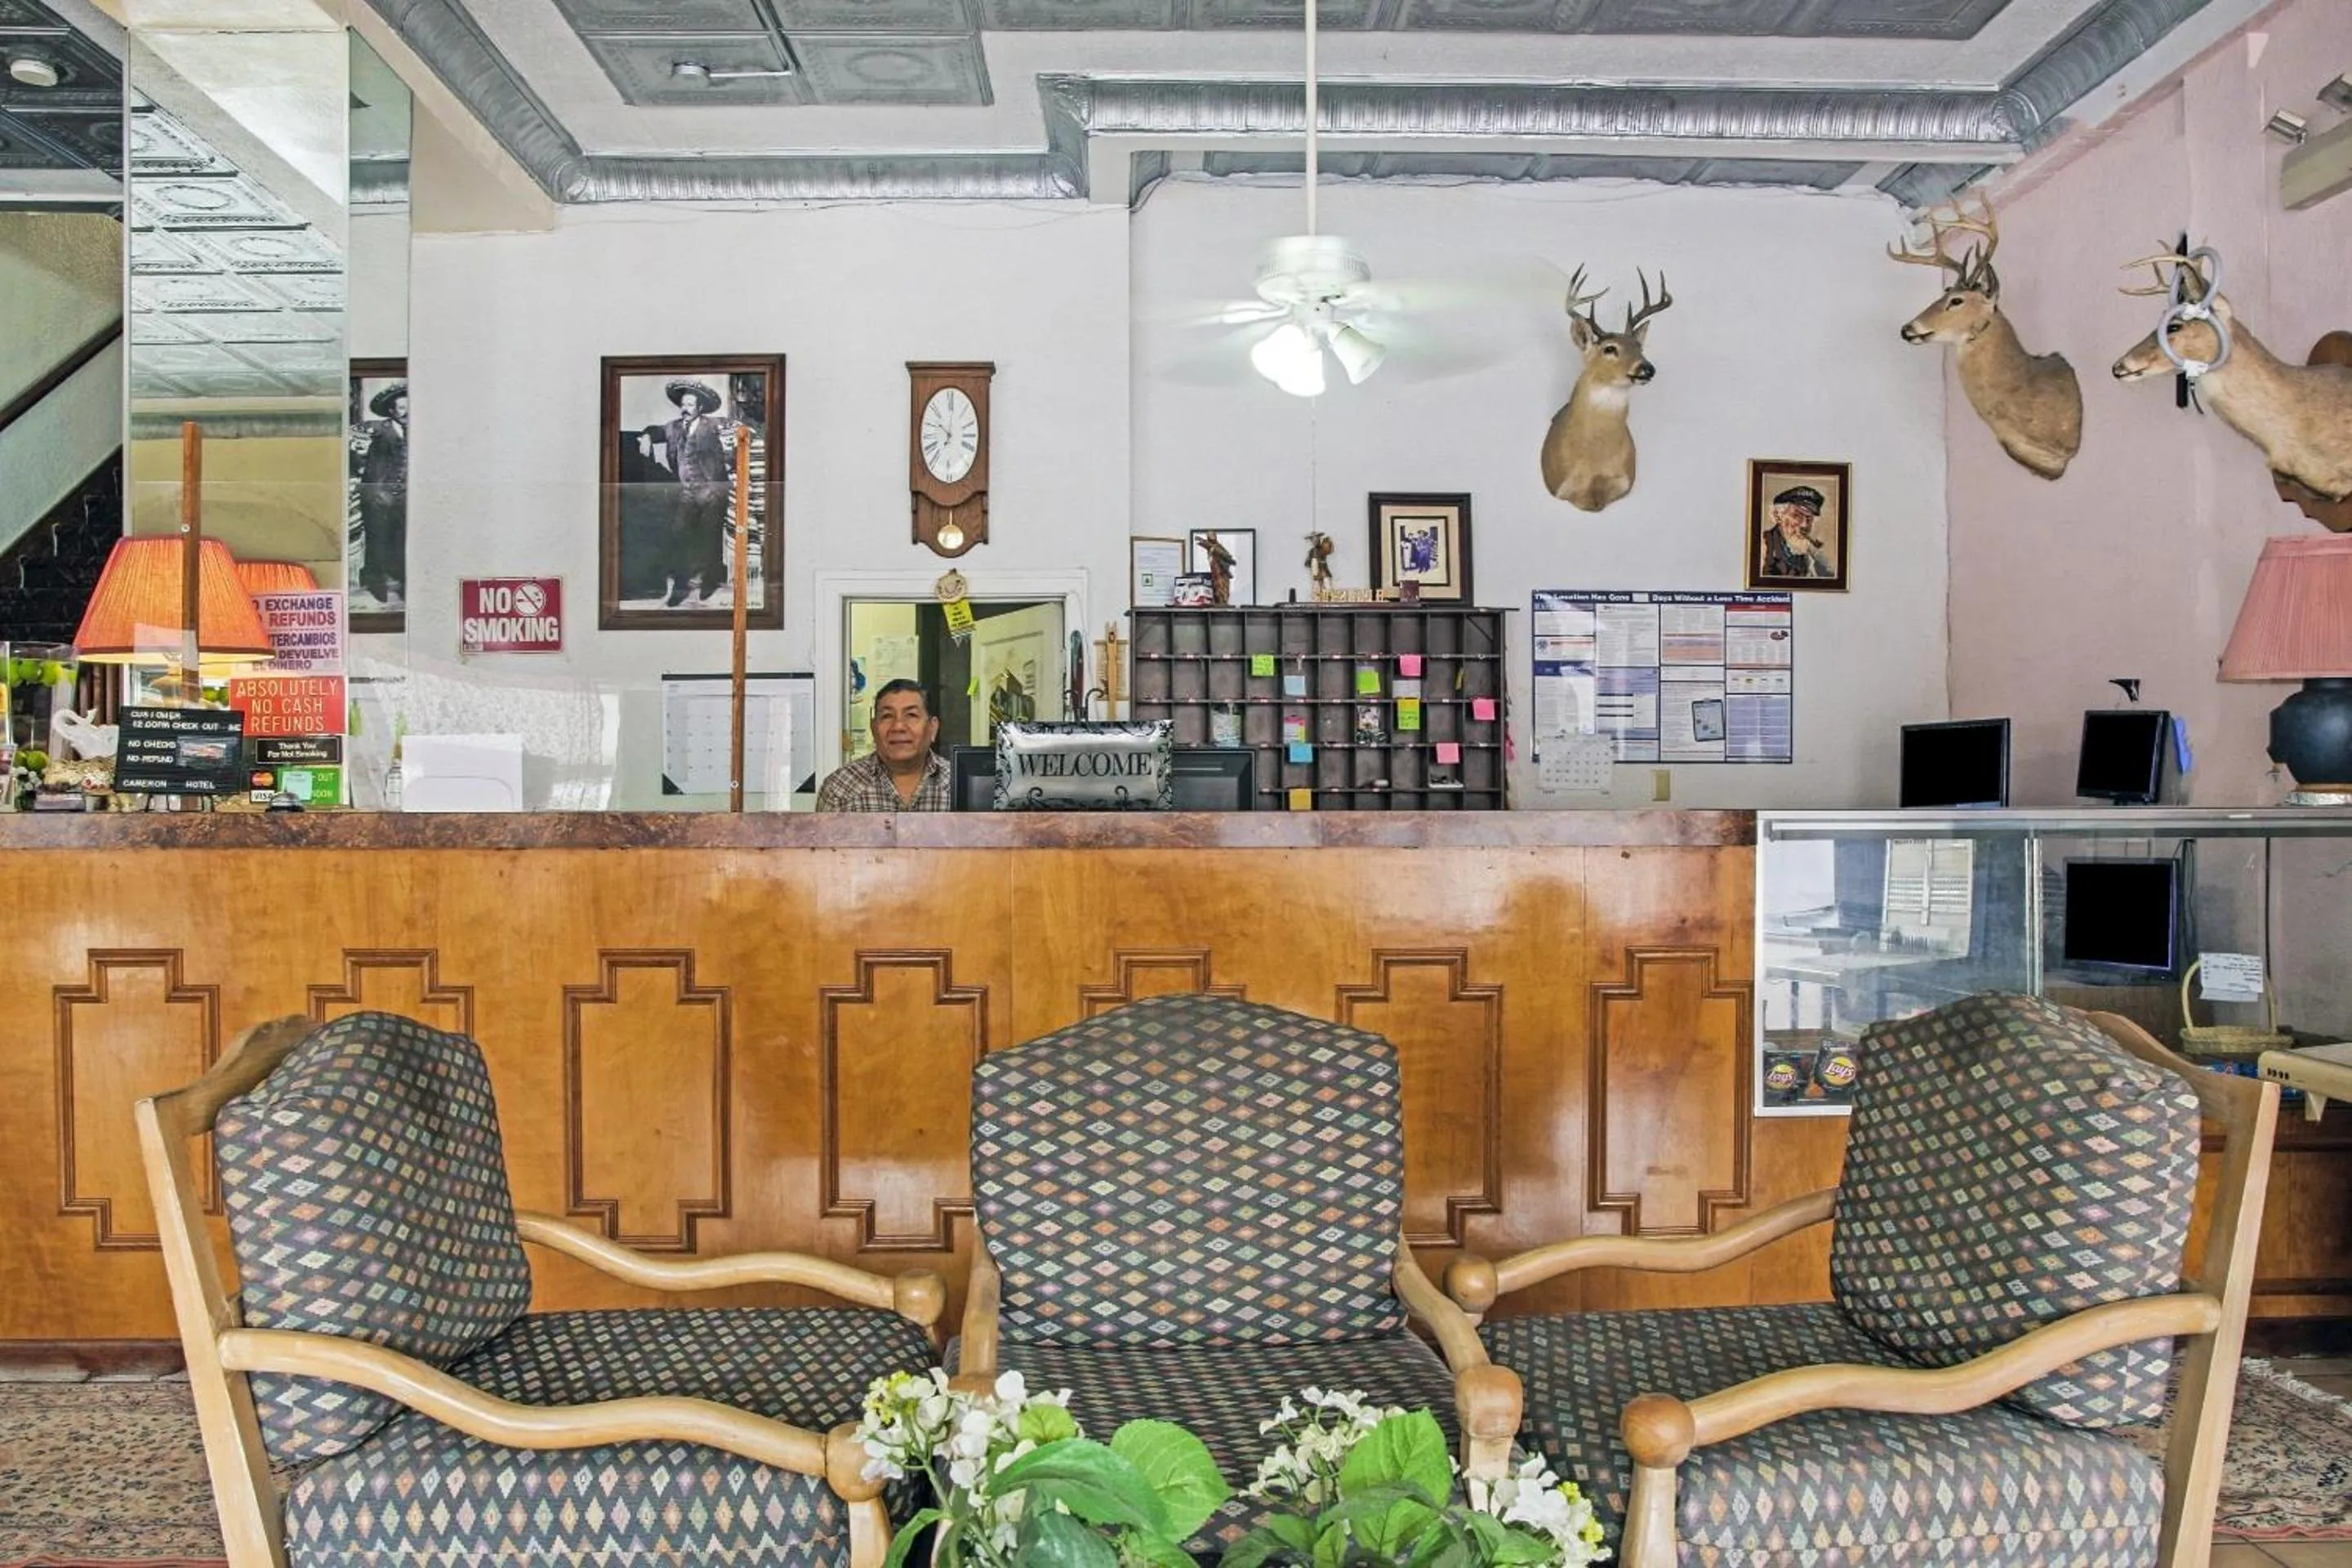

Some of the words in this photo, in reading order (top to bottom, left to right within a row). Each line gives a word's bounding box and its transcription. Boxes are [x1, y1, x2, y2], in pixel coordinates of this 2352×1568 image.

[265, 597, 333, 612] EXCHANGE
[479, 587, 511, 614] NO
[269, 611, 336, 627] REFUNDS
[463, 616, 559, 644] SMOKING
[268, 631, 336, 647] TERCAMBIOS
[278, 648, 339, 660] DEVUELVE
[268, 659, 313, 670] DINERO
[236, 679, 338, 698] ABSOLUTELY
[252, 698, 273, 715] NO
[282, 697, 323, 715] CASH
[251, 715, 325, 733] REFUNDS
[278, 742, 301, 750] Thank
[302, 741, 317, 749] You
[267, 751, 281, 759] For
[295, 750, 328, 760] Smoking
[1016, 751, 1152, 777] WELCOME
[122, 780, 167, 788] CAMERON
[185, 780, 216, 790] HOTEL
